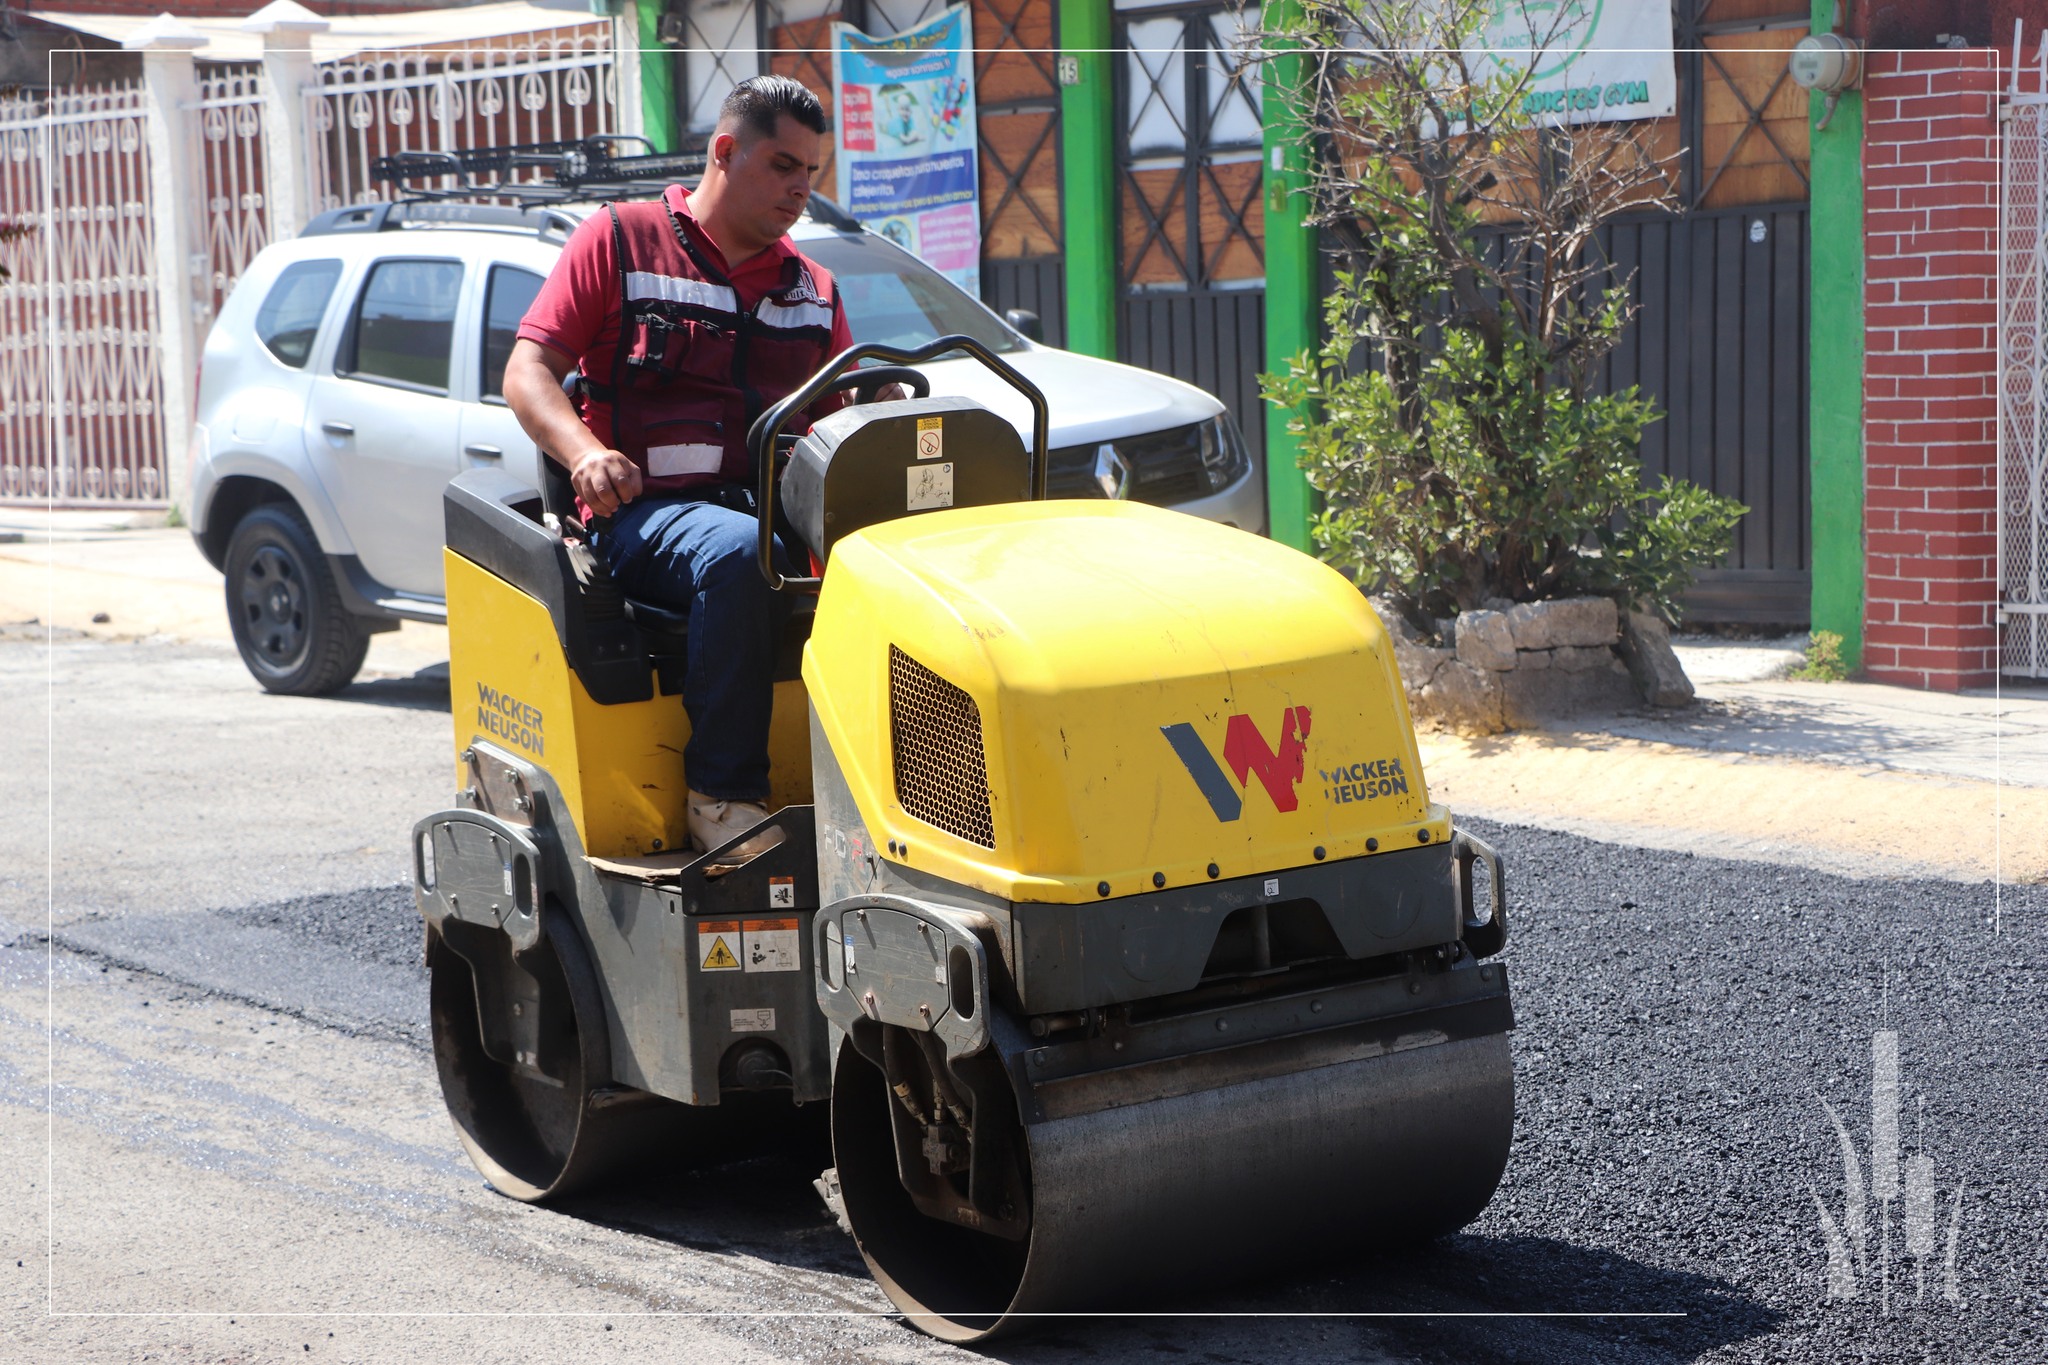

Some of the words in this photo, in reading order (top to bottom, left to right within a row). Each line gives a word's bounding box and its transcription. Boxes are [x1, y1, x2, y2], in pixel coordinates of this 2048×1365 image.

[1061, 63, 1076, 80] 15
[1604, 80, 1650, 106] GYM
[477, 681, 544, 733] WACKER
[478, 706, 544, 757] NEUSON
